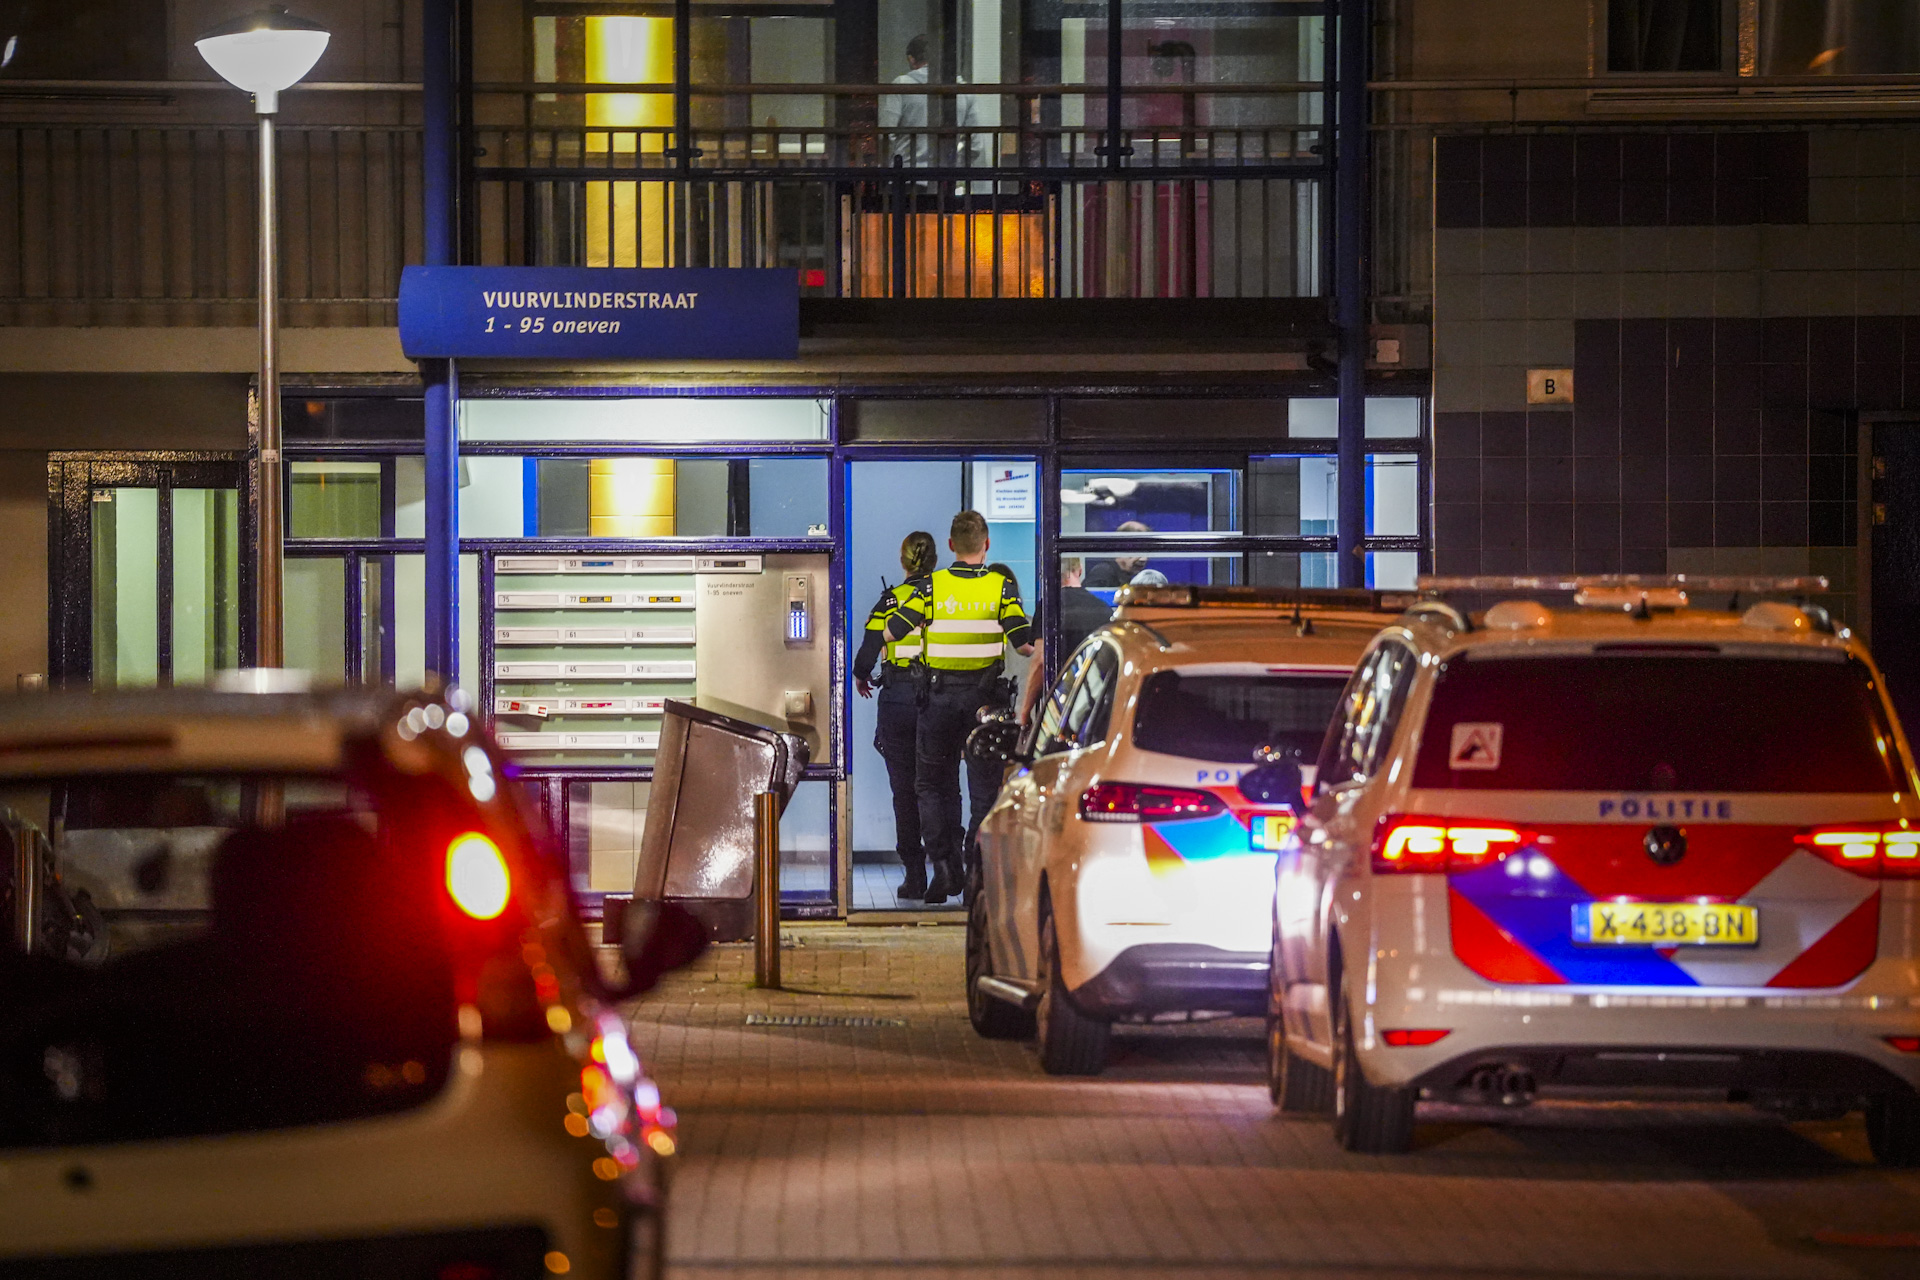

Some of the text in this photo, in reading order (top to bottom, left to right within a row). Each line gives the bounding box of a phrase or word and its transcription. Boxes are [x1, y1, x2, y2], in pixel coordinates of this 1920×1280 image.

[482, 291, 698, 309] VUURVLINDERSTRAAT
[484, 316, 495, 333] 1
[519, 316, 545, 333] 95
[552, 320, 621, 334] oneven
[1545, 378, 1555, 395] B
[1600, 800, 1731, 819] POLITIE
